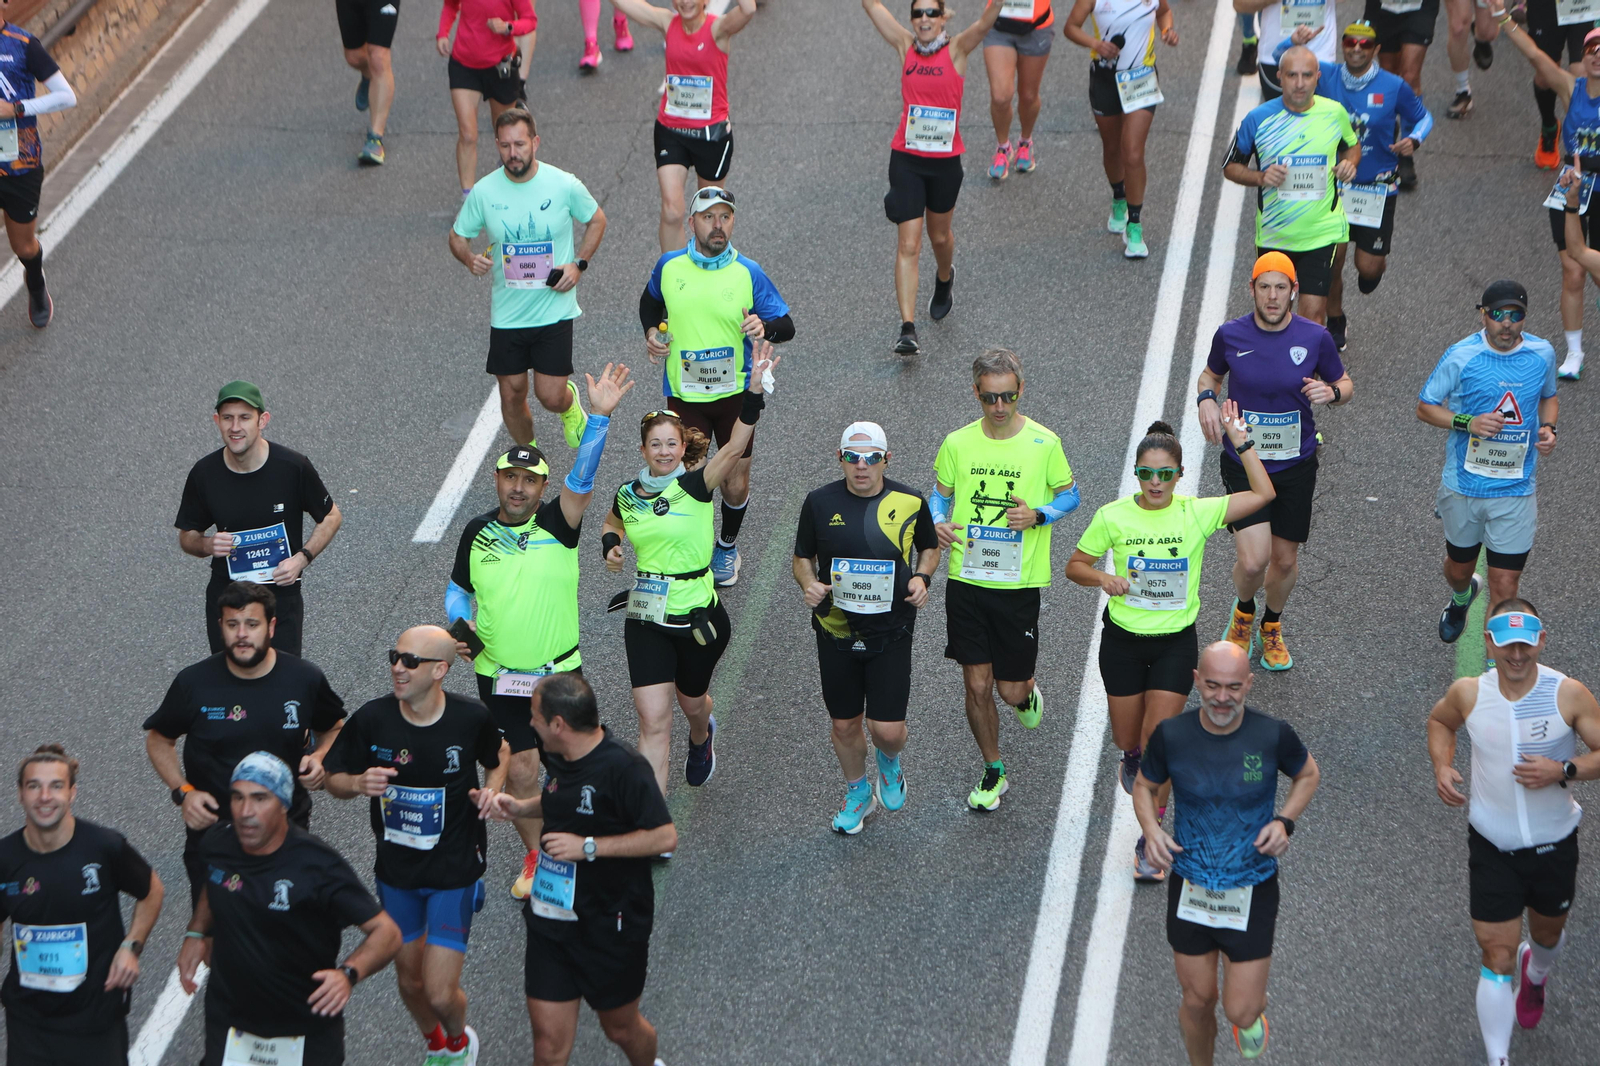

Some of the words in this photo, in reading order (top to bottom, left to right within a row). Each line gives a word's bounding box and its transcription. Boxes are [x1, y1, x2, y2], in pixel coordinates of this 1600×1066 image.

[682, 78, 706, 86] ZURICH
[924, 109, 950, 118] ZURICH
[1295, 157, 1322, 165] ZURICH
[519, 246, 546, 254] ZURICH
[699, 349, 728, 361] ZURICH
[700, 367, 717, 375] 8816
[1262, 416, 1292, 424] ZURICH
[1491, 433, 1521, 442] ZURICH
[1488, 449, 1507, 457] 9769
[1490, 460, 1516, 469] CABAÇA
[989, 468, 996, 476] &
[997, 469, 1021, 479] ABAS
[245, 530, 278, 543] ZURICH
[983, 529, 1015, 540] ZURICH
[1126, 538, 1146, 546] DIDI
[1156, 537, 1183, 545] ABAS
[246, 548, 271, 560] 12412
[982, 548, 1001, 557] 9666
[252, 560, 269, 569] RICK
[853, 563, 886, 572] ZURICH
[982, 560, 998, 568] JOSE
[1149, 561, 1182, 570] ZURICH
[638, 583, 662, 592] ZURICH
[852, 581, 872, 590] 9689
[1147, 579, 1167, 588] 9575
[842, 592, 857, 600] TITO
[1140, 589, 1174, 598] FERNANDA
[632, 599, 649, 609] 10632
[511, 679, 531, 687] 7740
[400, 791, 436, 802] ZURICH
[541, 858, 568, 875] ZURICH
[36, 930, 76, 942] ZURICH
